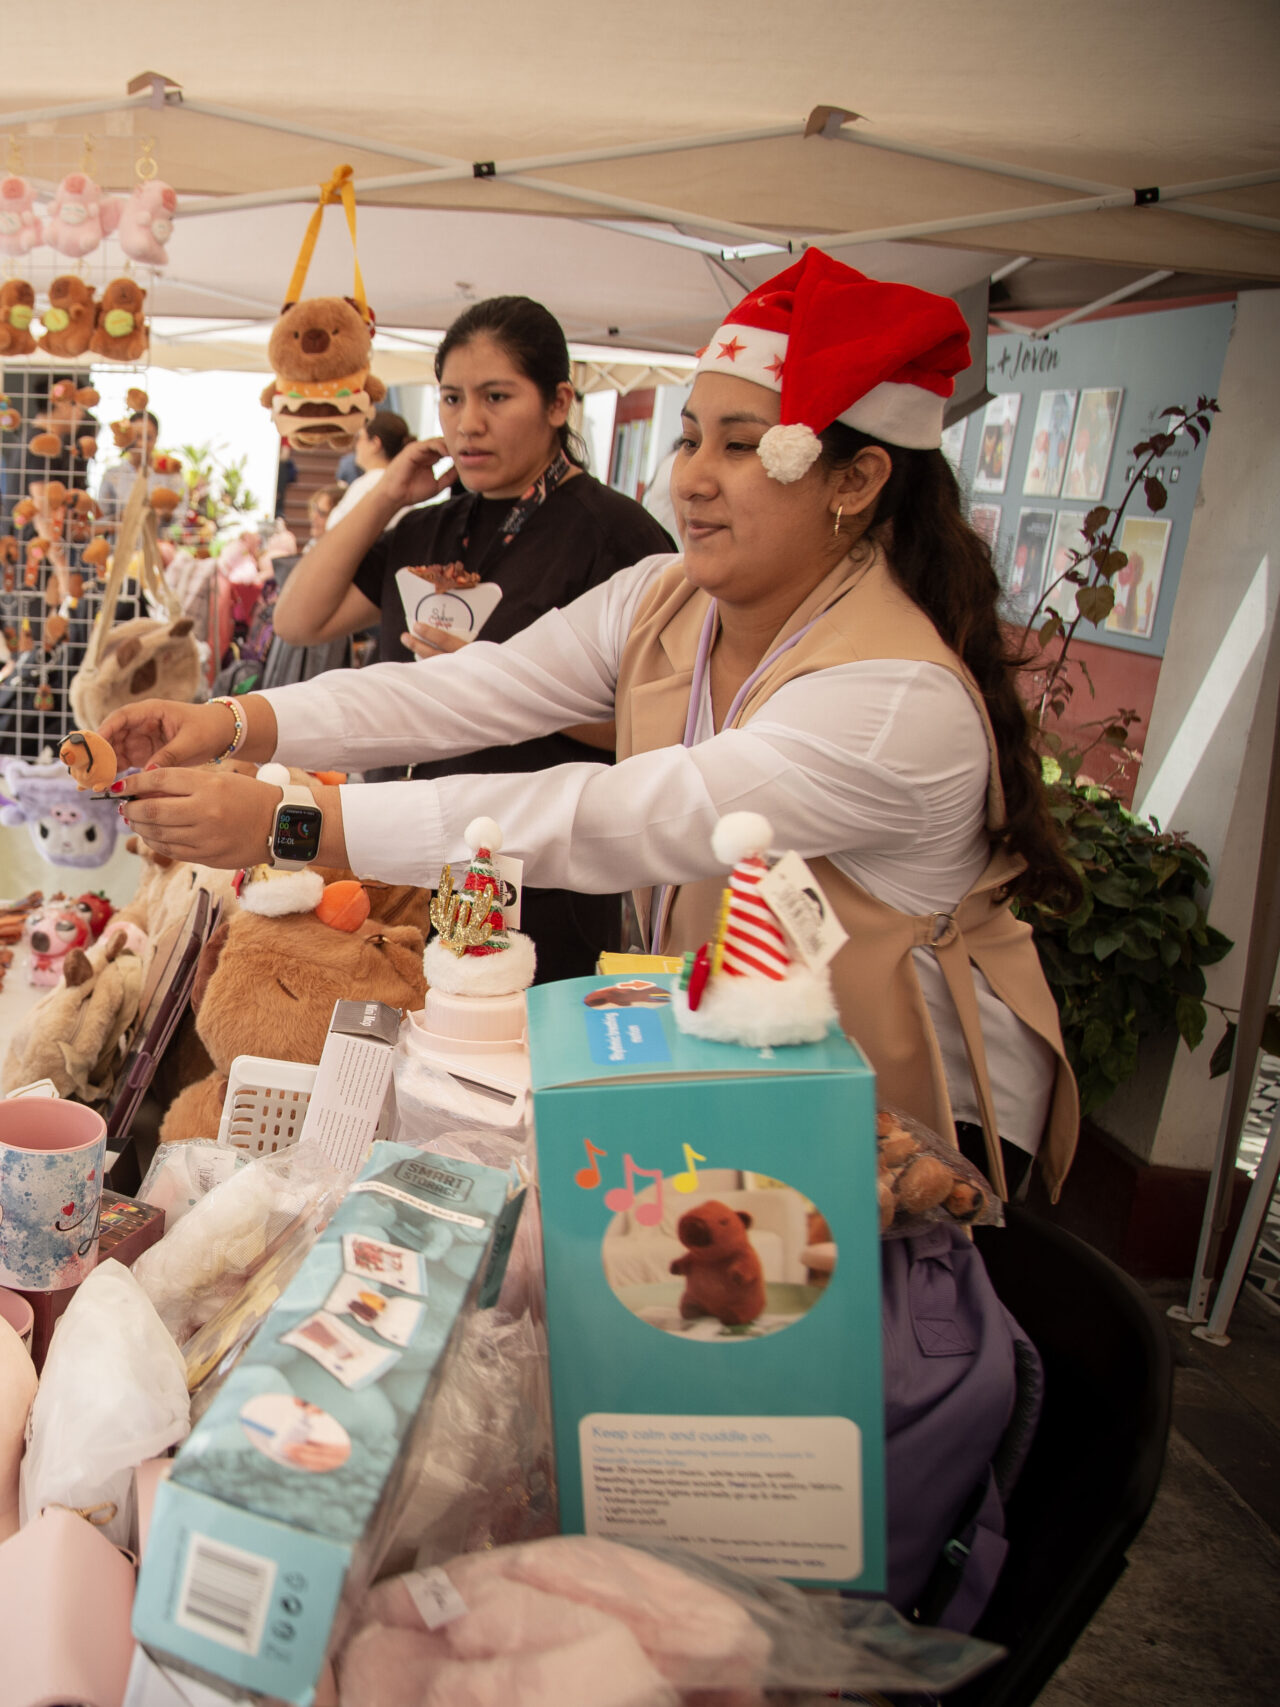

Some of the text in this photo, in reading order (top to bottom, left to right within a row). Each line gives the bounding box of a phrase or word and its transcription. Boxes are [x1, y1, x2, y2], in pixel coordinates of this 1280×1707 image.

[407, 1162, 467, 1188] SMART
[592, 1427, 628, 1441] Keep
[633, 1429, 665, 1441] calm
[670, 1430, 696, 1442] and
[700, 1430, 748, 1443] cuddle
